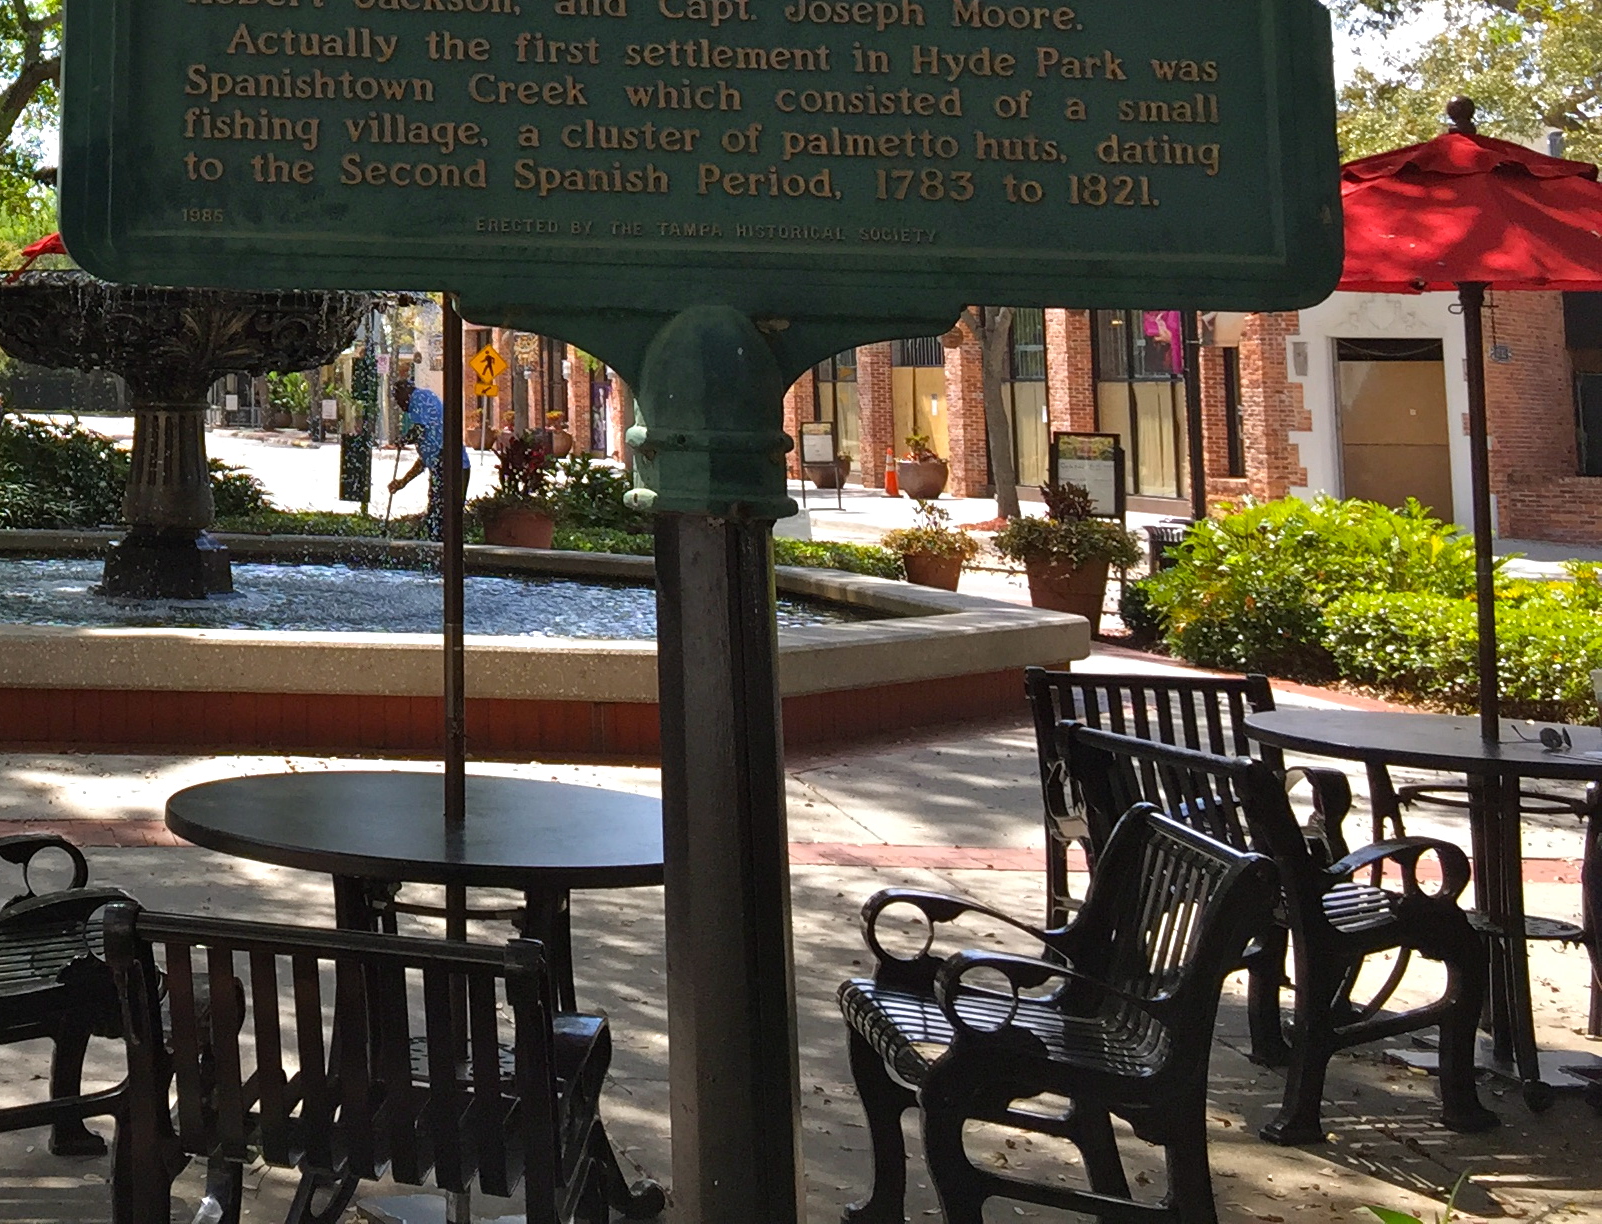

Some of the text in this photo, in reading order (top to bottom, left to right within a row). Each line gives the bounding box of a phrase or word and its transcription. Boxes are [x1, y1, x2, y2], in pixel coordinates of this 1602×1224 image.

[228, 24, 1218, 83] Actually the first settlement in Hyde Park was
[185, 63, 1219, 124] Spanishtown Creek which consisted of a small
[184, 108, 1220, 176] fishing village, a cluster of palmetto huts, dating
[184, 152, 1159, 208] to the Second Spanish Period, 1783 to 1821.
[476, 217, 937, 243] ERECTED BY THE TAMPA HISTORICAL SOCIETY
